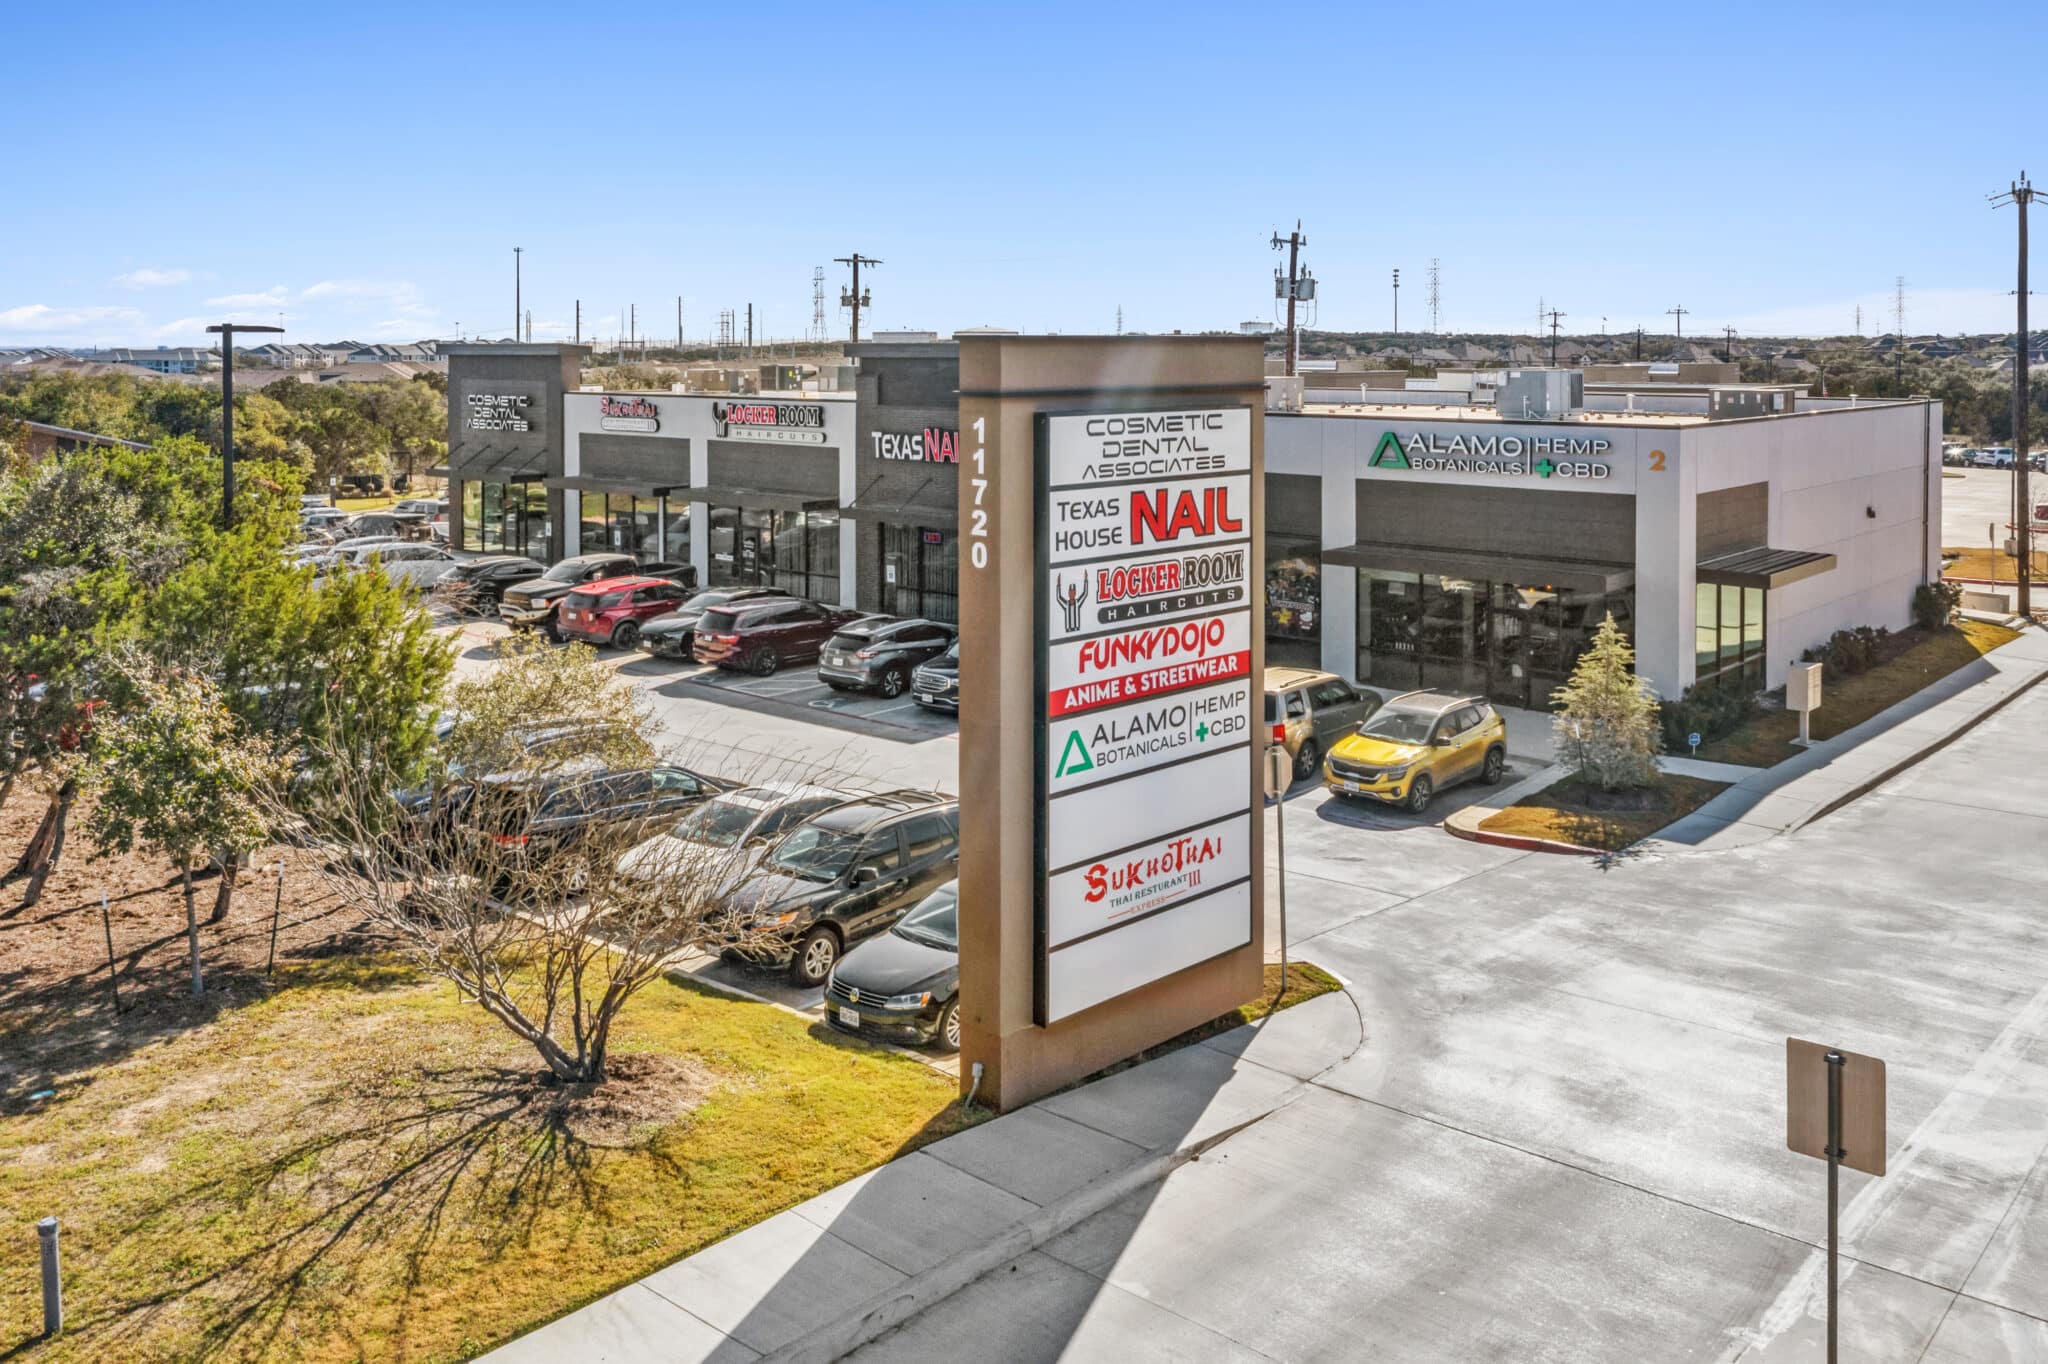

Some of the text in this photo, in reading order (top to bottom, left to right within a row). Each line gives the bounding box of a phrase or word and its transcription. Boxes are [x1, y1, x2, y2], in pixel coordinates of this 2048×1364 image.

[467, 394, 528, 408] COSMETIC
[473, 407, 521, 419] DENTAL
[466, 418, 529, 432] ASSOCIATES
[727, 404, 820, 427] LOCKER ROOM
[1086, 413, 1223, 437] COSMETIC
[736, 430, 818, 441] HAIRCUTS
[871, 428, 960, 463] TEXAS NAI
[1102, 436, 1209, 458] DENTAL
[1406, 433, 1610, 457] ALAMO HEMP
[1082, 455, 1226, 480] ASSOCIATES
[1411, 457, 1524, 476] BOTANICALS
[1649, 450, 1666, 472] 2
[971, 417, 988, 569] 11720
[1057, 498, 1120, 522] TEXAS
[1130, 486, 1243, 546] NAIL
[1055, 526, 1122, 552] HOUSE
[1097, 550, 1244, 604] LOCKER ROOM
[1108, 589, 1235, 620] HAIRCUTS
[1064, 655, 1238, 709] ANIME & STREETWEAR
[1091, 690, 1246, 749] ALAMO HEMP
[1096, 731, 1187, 767] BOTANICALS
[1084, 836, 1222, 903] SUKHOTHAI
[1109, 894, 1133, 908] THAI
[1134, 874, 1189, 900] RESTURANT
